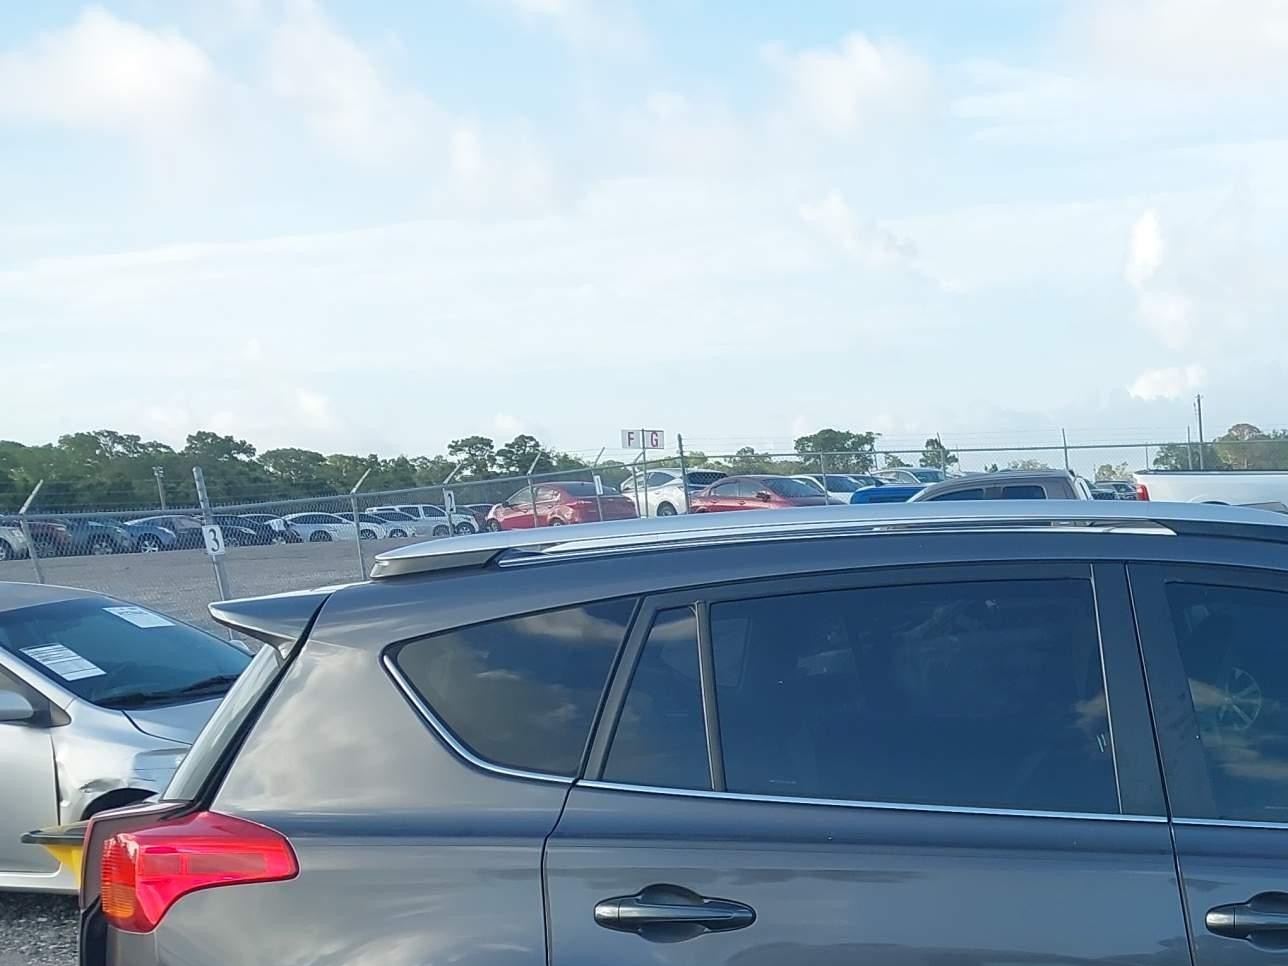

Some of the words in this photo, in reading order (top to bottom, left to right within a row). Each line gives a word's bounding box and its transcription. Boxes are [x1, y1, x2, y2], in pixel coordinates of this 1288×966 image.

[627, 431, 635, 447] F
[650, 431, 659, 448] G
[208, 528, 220, 552] 3
